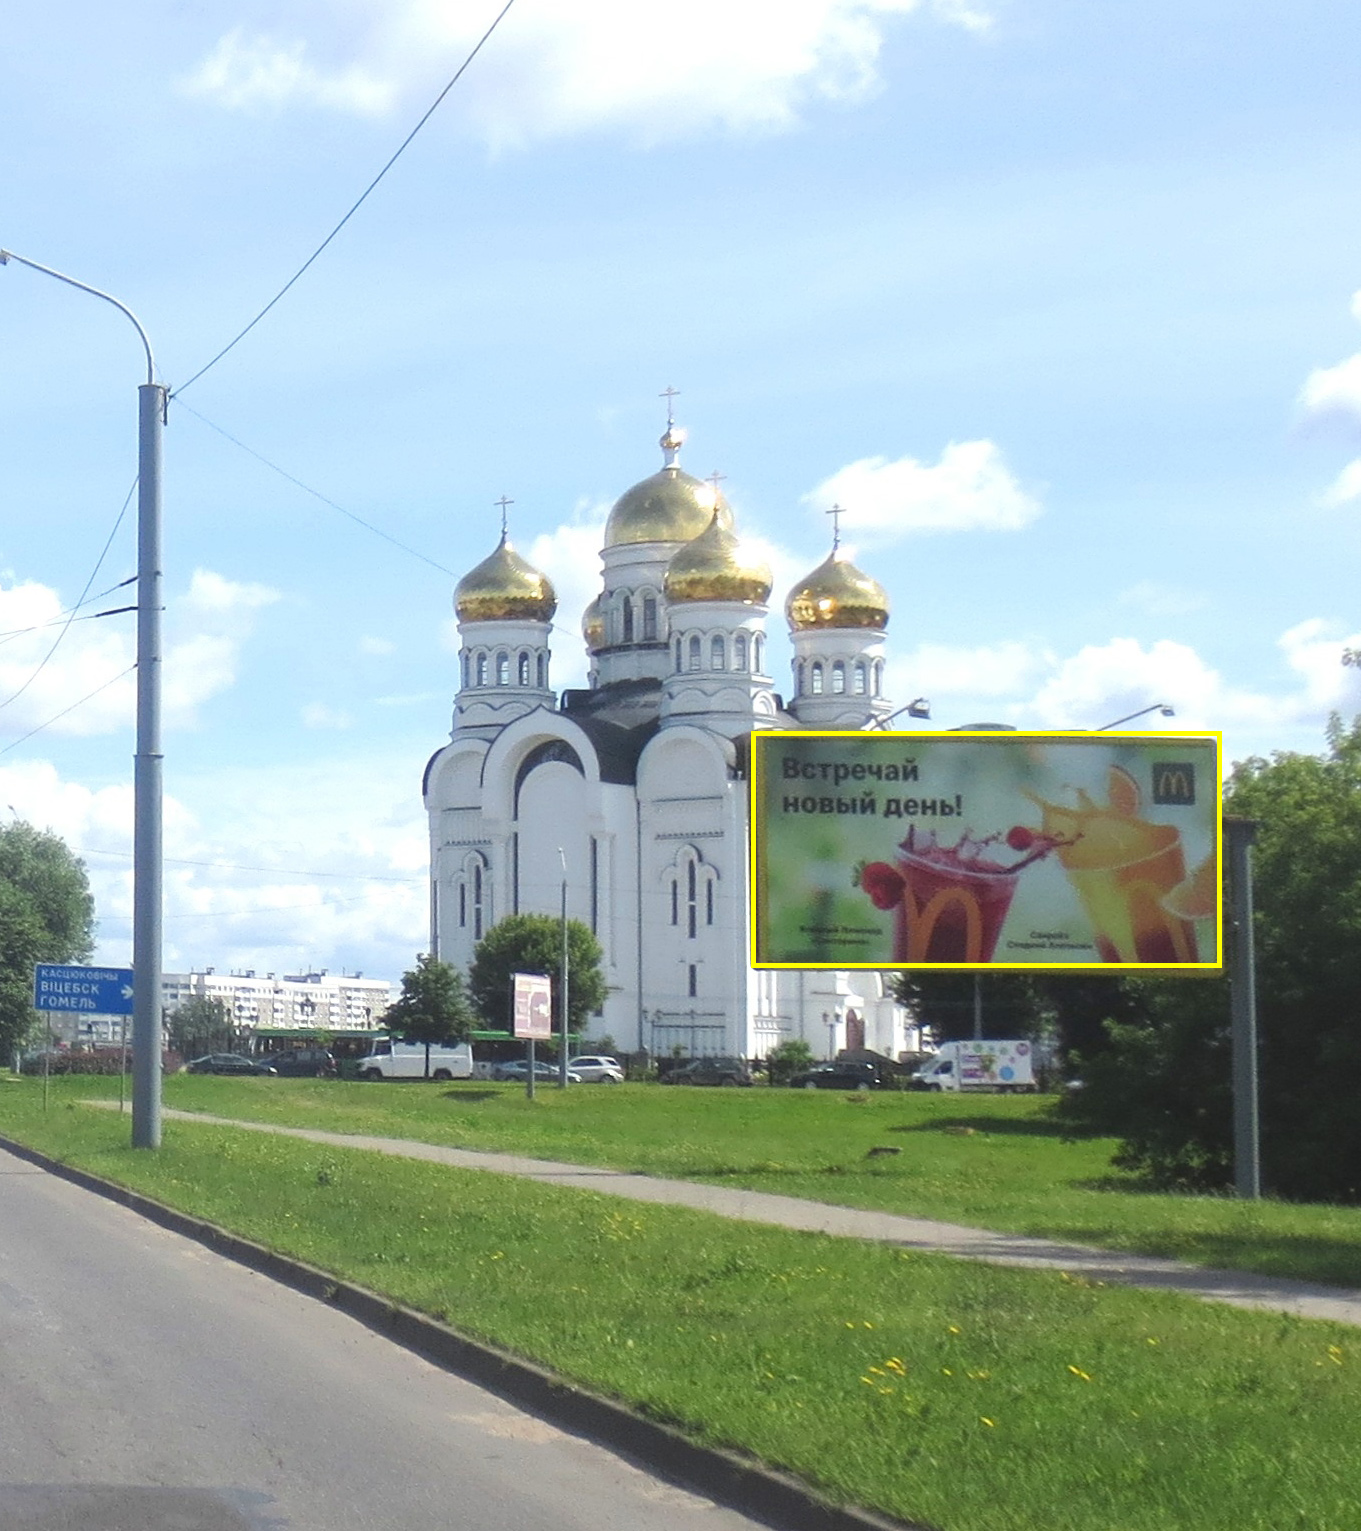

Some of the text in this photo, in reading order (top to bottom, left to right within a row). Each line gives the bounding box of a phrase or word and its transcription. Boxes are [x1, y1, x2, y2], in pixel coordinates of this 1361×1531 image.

[782, 757, 919, 786] Встречай
[782, 790, 963, 818] новый день!
[41, 981, 100, 995] ВІЦЕБСК
[40, 995, 97, 1009] ГОМЕЛЬ
